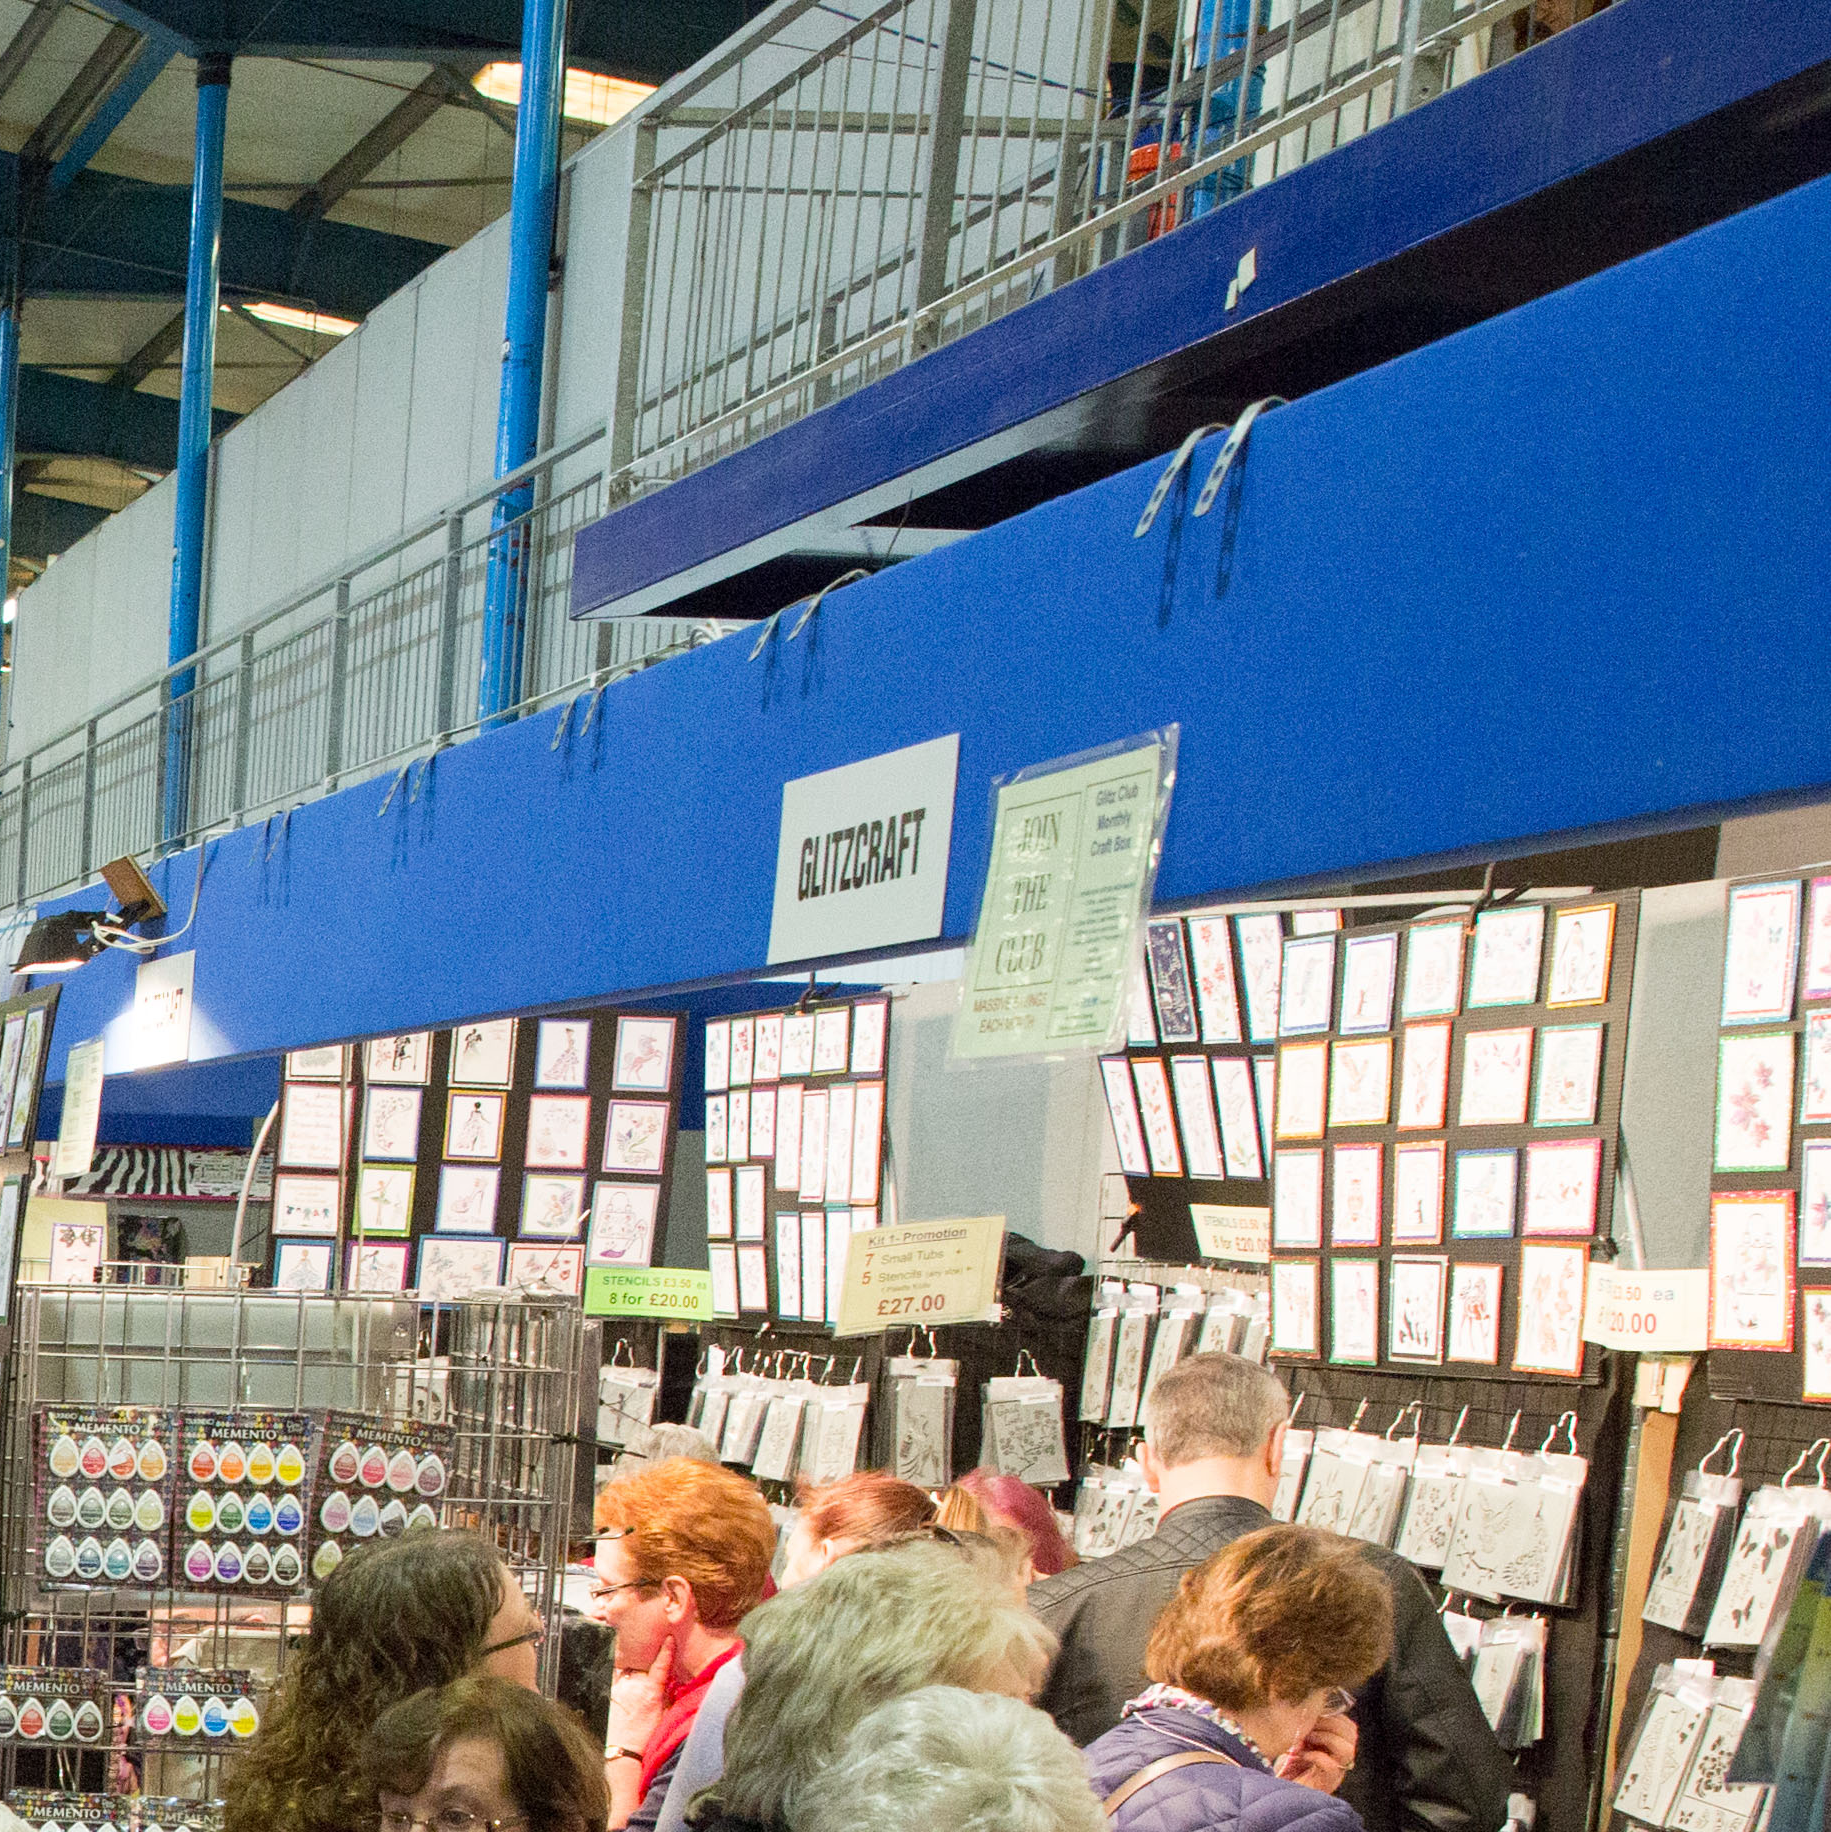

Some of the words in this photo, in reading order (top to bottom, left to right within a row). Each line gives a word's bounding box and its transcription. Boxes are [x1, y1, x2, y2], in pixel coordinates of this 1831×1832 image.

[1019, 811, 1062, 852] JOIN
[798, 807, 926, 901] GLITZCRAFT
[1013, 874, 1052, 914] THE
[995, 932, 1046, 976] CLUB
[868, 1236, 885, 1247] Kit
[903, 1227, 967, 1242] Promotion
[865, 1253, 874, 1267] 7
[881, 1252, 913, 1265] Small
[917, 1249, 944, 1261] Tubs
[602, 1276, 660, 1286] STENCILS
[663, 1278, 691, 1288] £3.50
[862, 1271, 872, 1285] 5
[878, 1270, 921, 1283] Stencils
[610, 1293, 617, 1305] 8
[622, 1292, 644, 1305] for
[649, 1293, 698, 1309] £20.00
[1653, 1289, 1674, 1301] ea
[877, 1294, 945, 1316] £27.00
[73, 1422, 141, 1436] MEMENTO
[211, 1428, 277, 1440] MEMENTO
[355, 1427, 423, 1447] MEMENTO
[14, 1680, 80, 1694] MEMENTO
[165, 1681, 233, 1693] MEMENTO
[33, 1806, 101, 1820] MEMENTO
[165, 1812, 223, 1824] MEMENT
